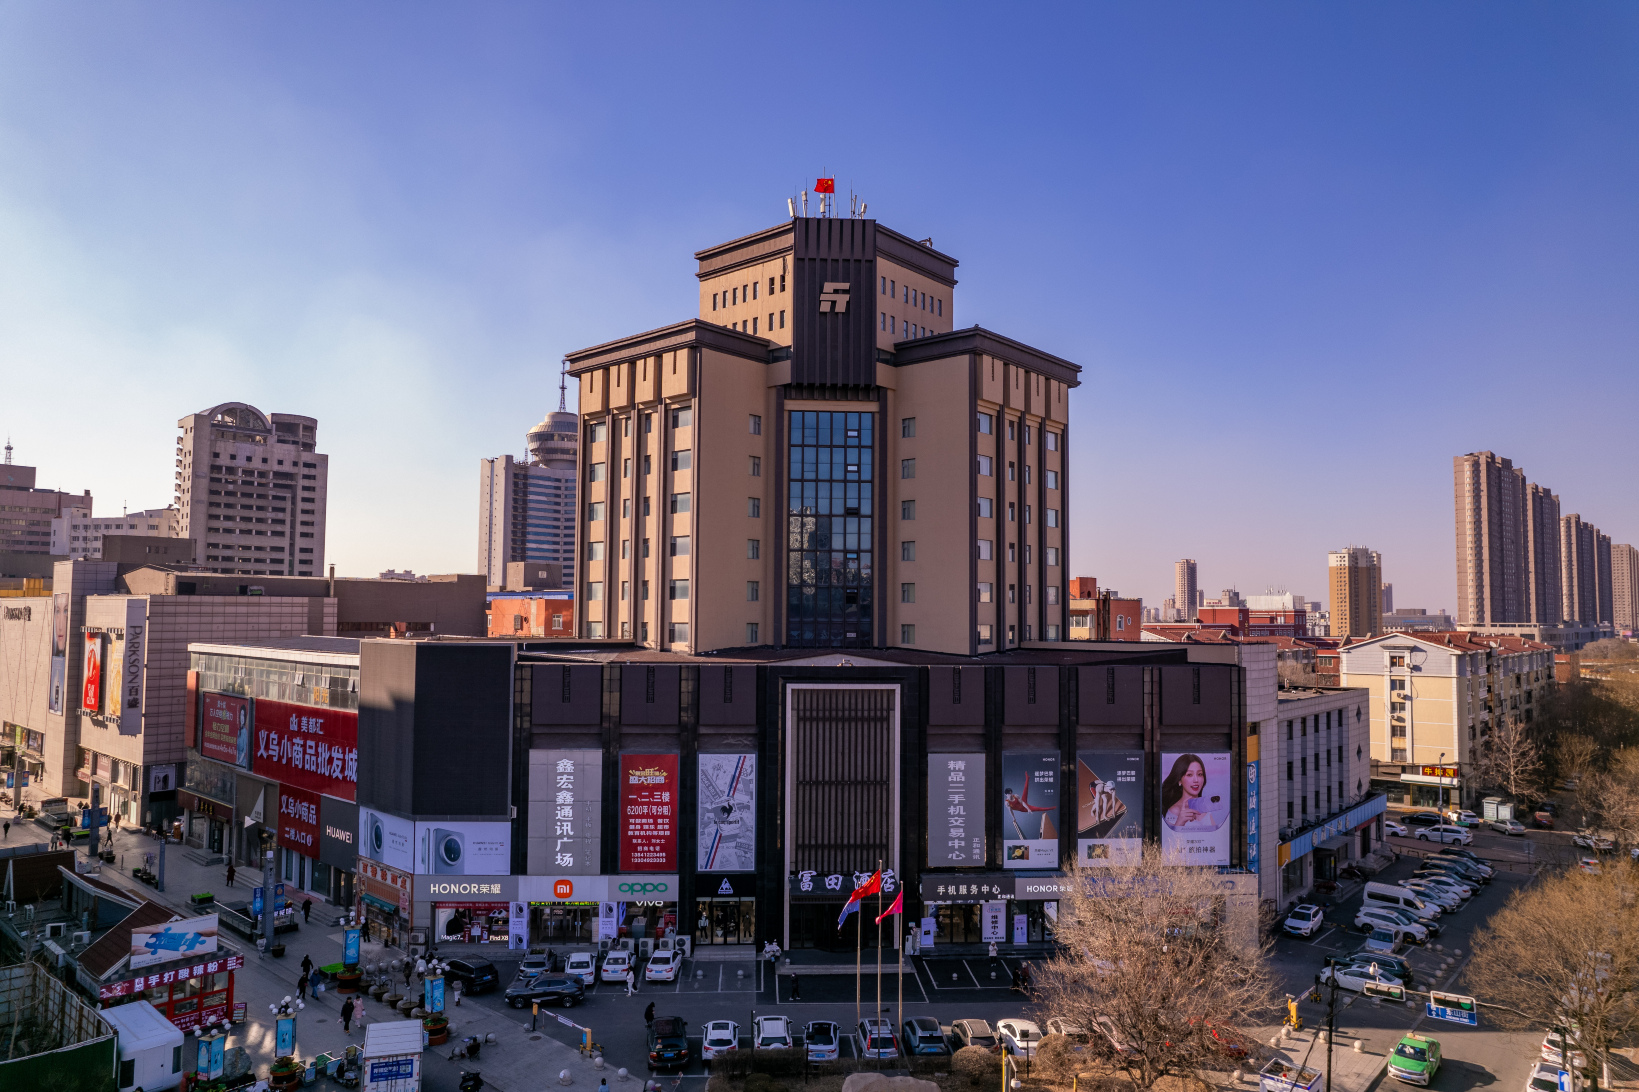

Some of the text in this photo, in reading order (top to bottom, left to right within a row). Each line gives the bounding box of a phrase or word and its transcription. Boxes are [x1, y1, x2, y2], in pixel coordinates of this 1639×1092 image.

[314, 687, 329, 703] 阳光
[301, 716, 324, 735] 美都汇
[257, 729, 357, 783] 义乌小商品批发城
[629, 791, 670, 802] 一、二、三楼
[280, 795, 317, 825] 义乌小商品
[555, 758, 575, 867] 鑫宏鑫通讯广场
[947, 760, 966, 860] 精品二手机交易中心
[285, 827, 306, 845] 二楼入口
[326, 825, 353, 844] HUAWEI
[937, 884, 1001, 895] 手机服务中心
[148, 961, 218, 987] 手打酸辣粉
